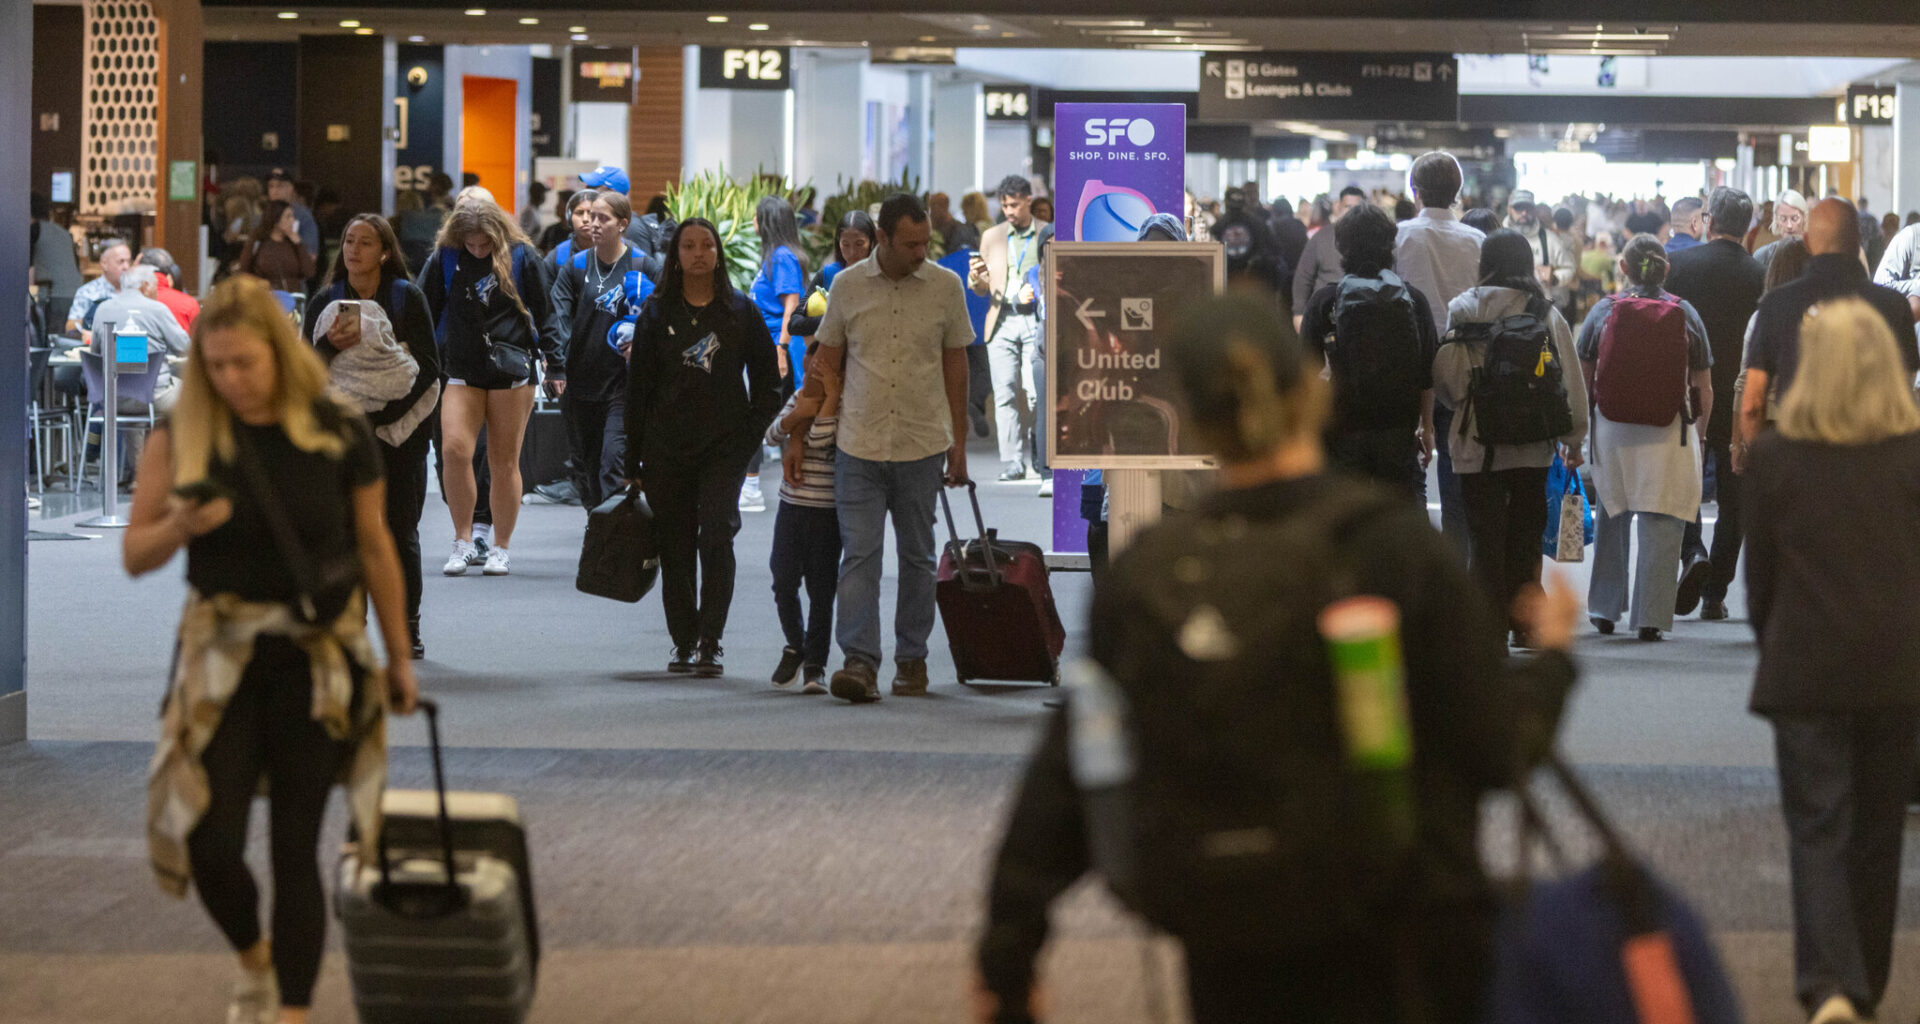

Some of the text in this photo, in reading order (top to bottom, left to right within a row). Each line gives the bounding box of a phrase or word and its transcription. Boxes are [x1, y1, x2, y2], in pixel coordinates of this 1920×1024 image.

[724, 49, 781, 79] F12
[1247, 63, 1298, 77] G Gates
[1247, 83, 1352, 99] Lounges & Clubs
[986, 92, 1029, 116] F14
[1854, 95, 1894, 118] F13
[1085, 118, 1155, 146] SFO
[1069, 152, 1170, 160] SHOP. DINE. SFO.
[1078, 349, 1160, 369] United
[1077, 379, 1133, 401] Club
